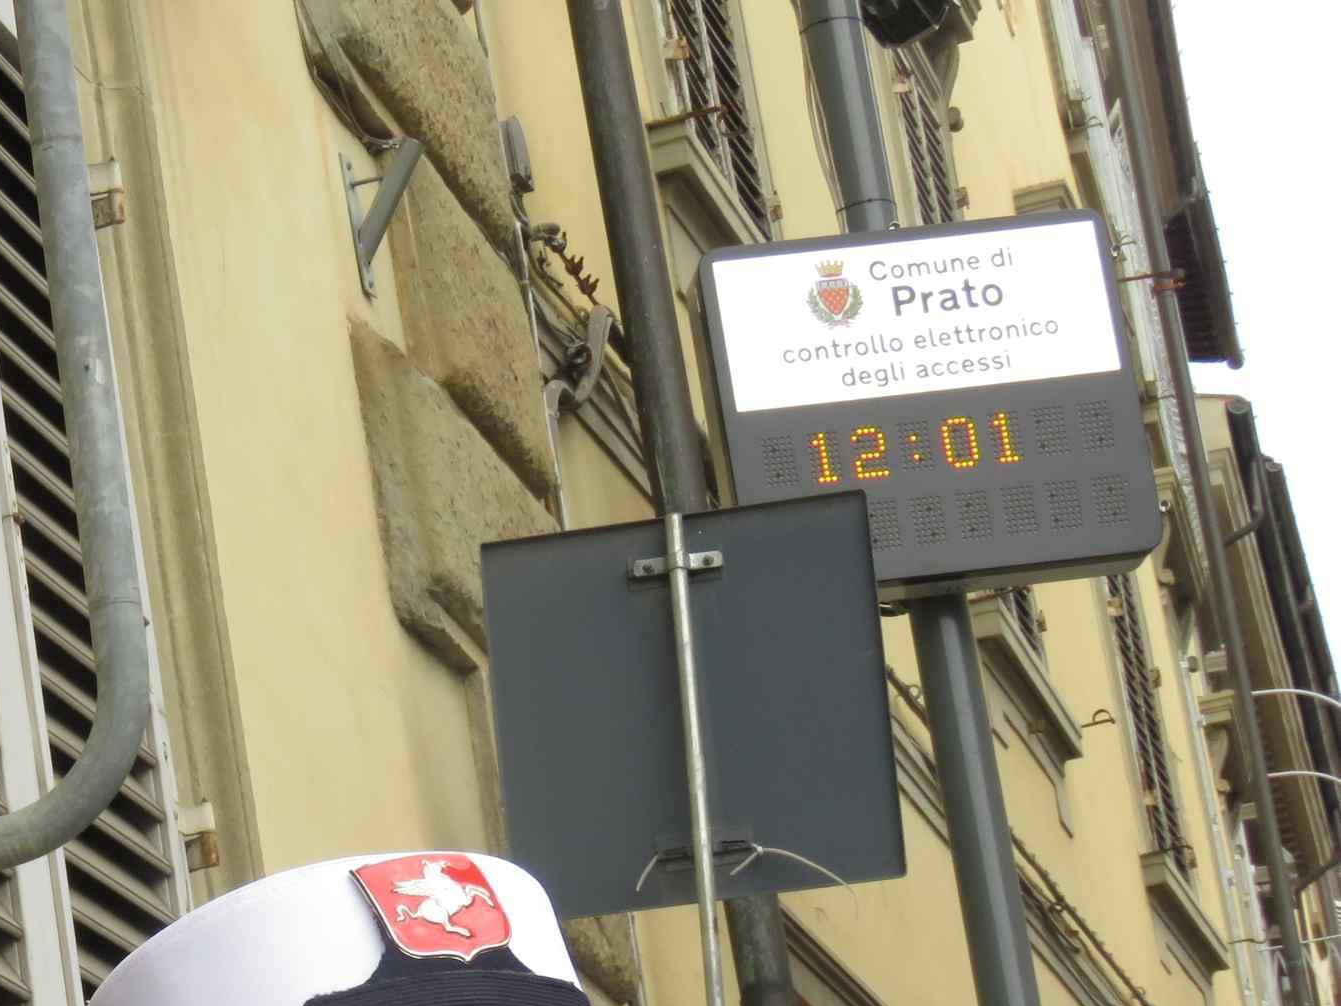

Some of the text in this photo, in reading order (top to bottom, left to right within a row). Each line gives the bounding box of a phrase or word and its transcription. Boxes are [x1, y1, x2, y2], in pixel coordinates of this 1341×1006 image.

[869, 247, 1014, 281] Comune di
[891, 278, 1004, 317] Prato
[782, 318, 1059, 364] controllo elettronico
[841, 350, 1012, 388] degli accessi
[809, 410, 1023, 484] 12:01
